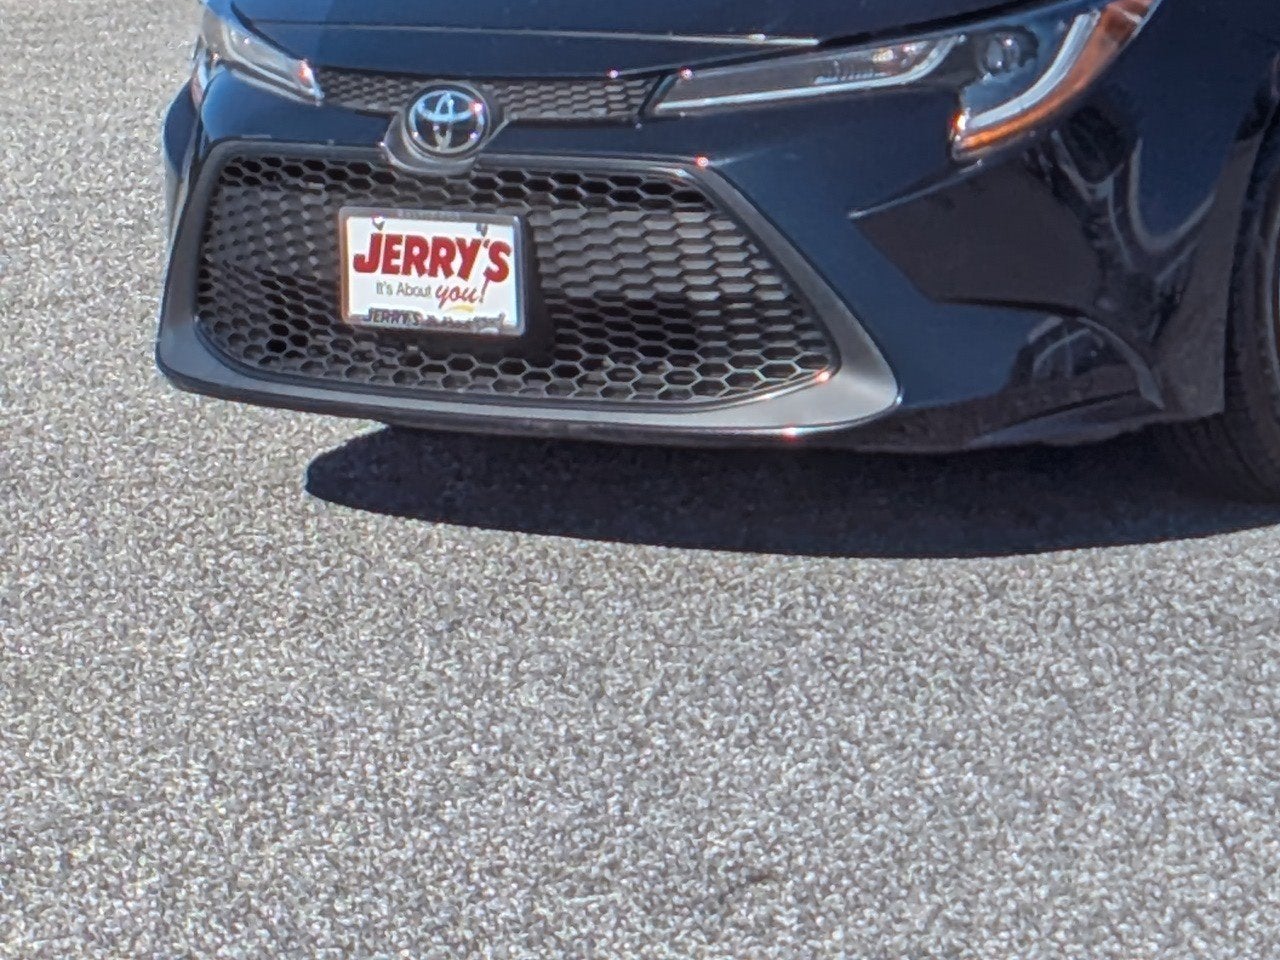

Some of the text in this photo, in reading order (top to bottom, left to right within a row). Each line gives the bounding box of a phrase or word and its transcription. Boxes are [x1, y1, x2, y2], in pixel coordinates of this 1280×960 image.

[353, 232, 512, 283] JERRY'S
[376, 277, 491, 309] It's About you!
